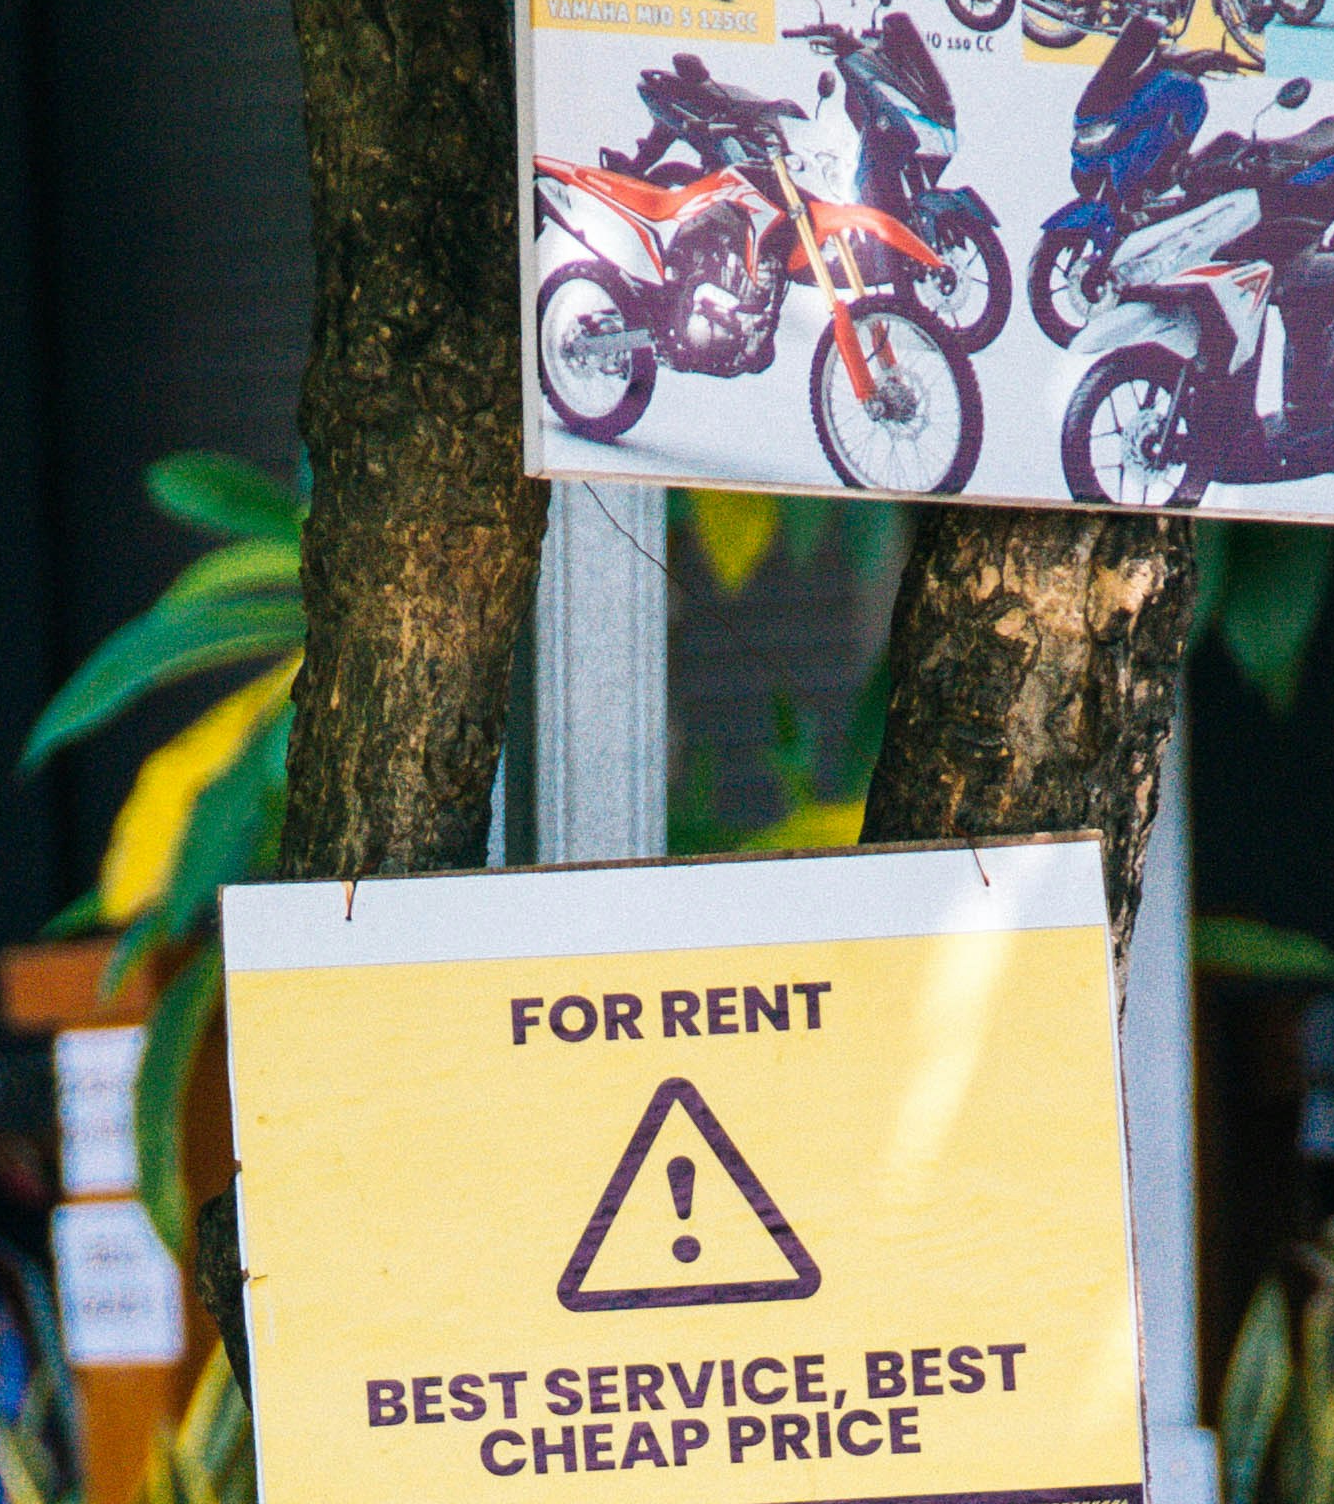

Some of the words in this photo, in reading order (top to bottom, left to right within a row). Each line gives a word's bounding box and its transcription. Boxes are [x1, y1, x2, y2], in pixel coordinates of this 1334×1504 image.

[636, 5, 674, 28] MIO
[681, 9, 693, 29] S
[699, 10, 758, 35] 125CC
[947, 37, 971, 50] 150
[976, 34, 994, 52] CC
[510, 994, 644, 1045] FOR
[662, 981, 833, 1037] RENT
[367, 1370, 529, 1428] BEST
[544, 1352, 851, 1418] SERVICE,
[867, 1342, 1028, 1400] BEST
[478, 1417, 711, 1478] CHEAP
[729, 1407, 923, 1464] PRICE
